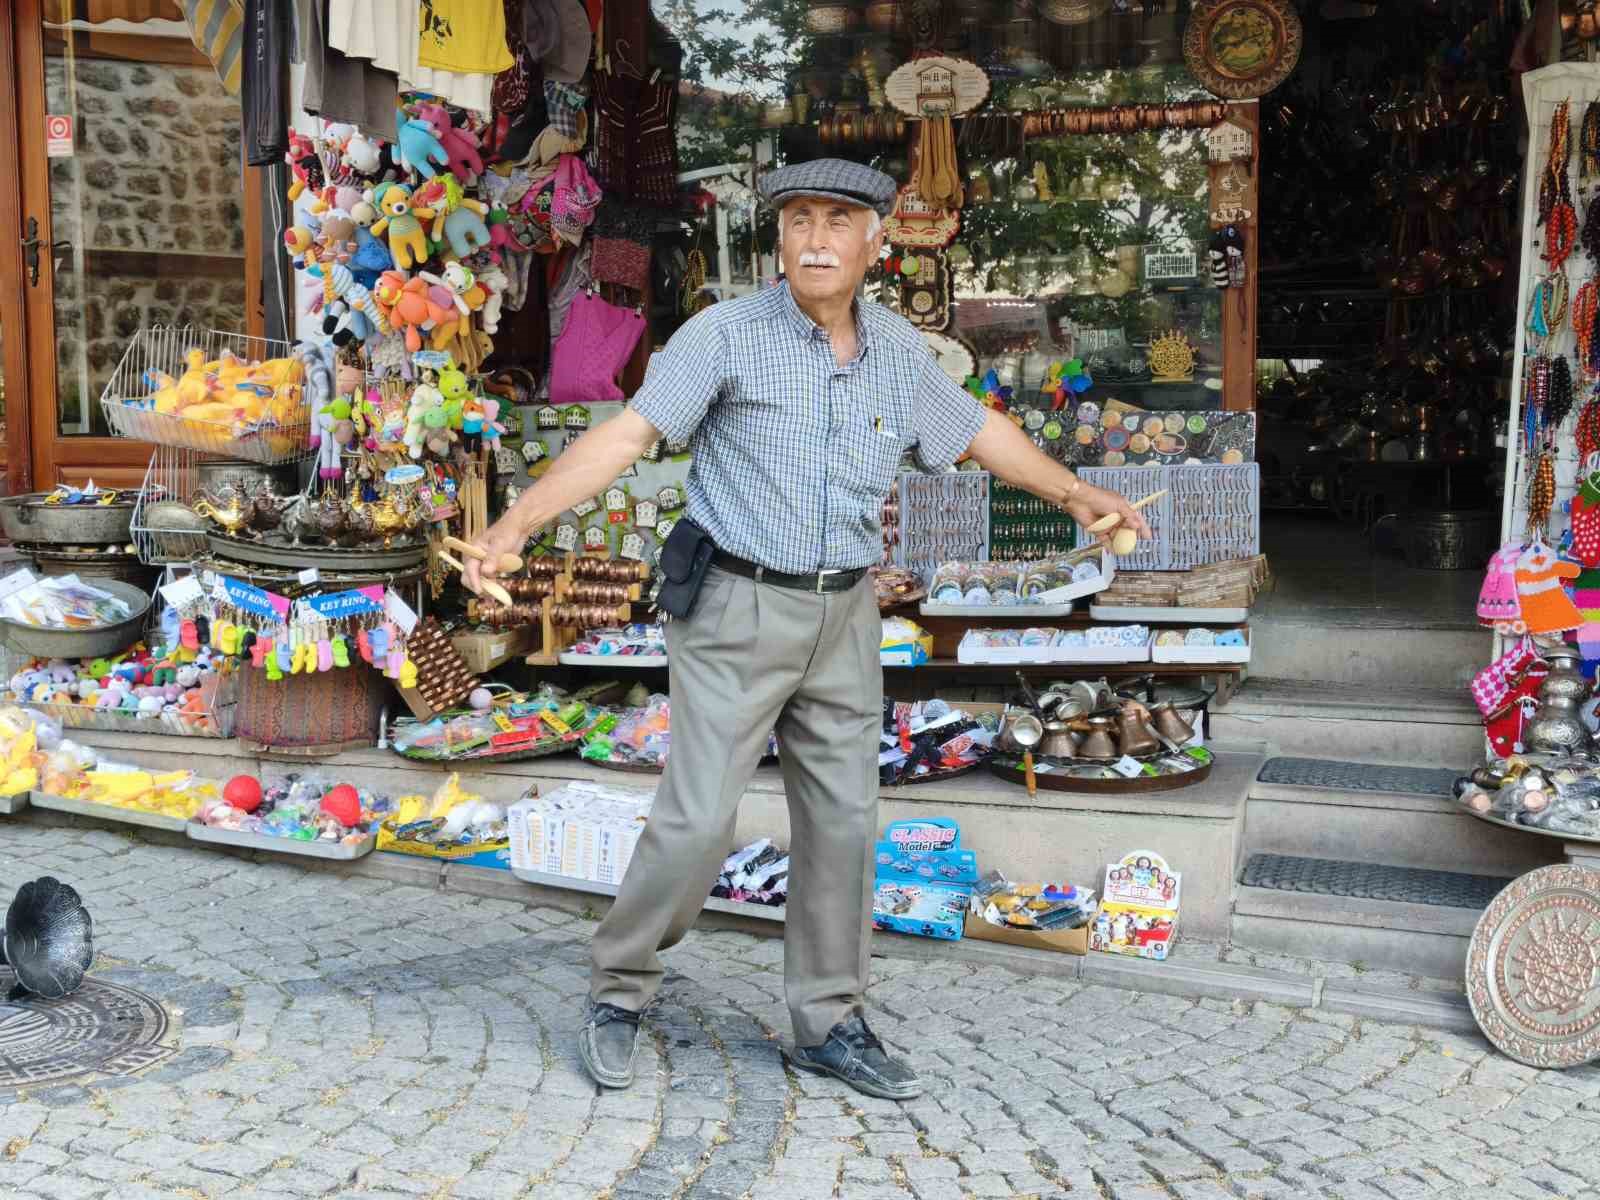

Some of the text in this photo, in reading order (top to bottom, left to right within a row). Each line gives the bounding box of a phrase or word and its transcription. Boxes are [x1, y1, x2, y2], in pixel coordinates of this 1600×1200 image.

[230, 587, 270, 607] KEY RING
[320, 596, 366, 611] KEY RING
[892, 829, 954, 842] CLASSIC
[898, 842, 932, 851] Model
